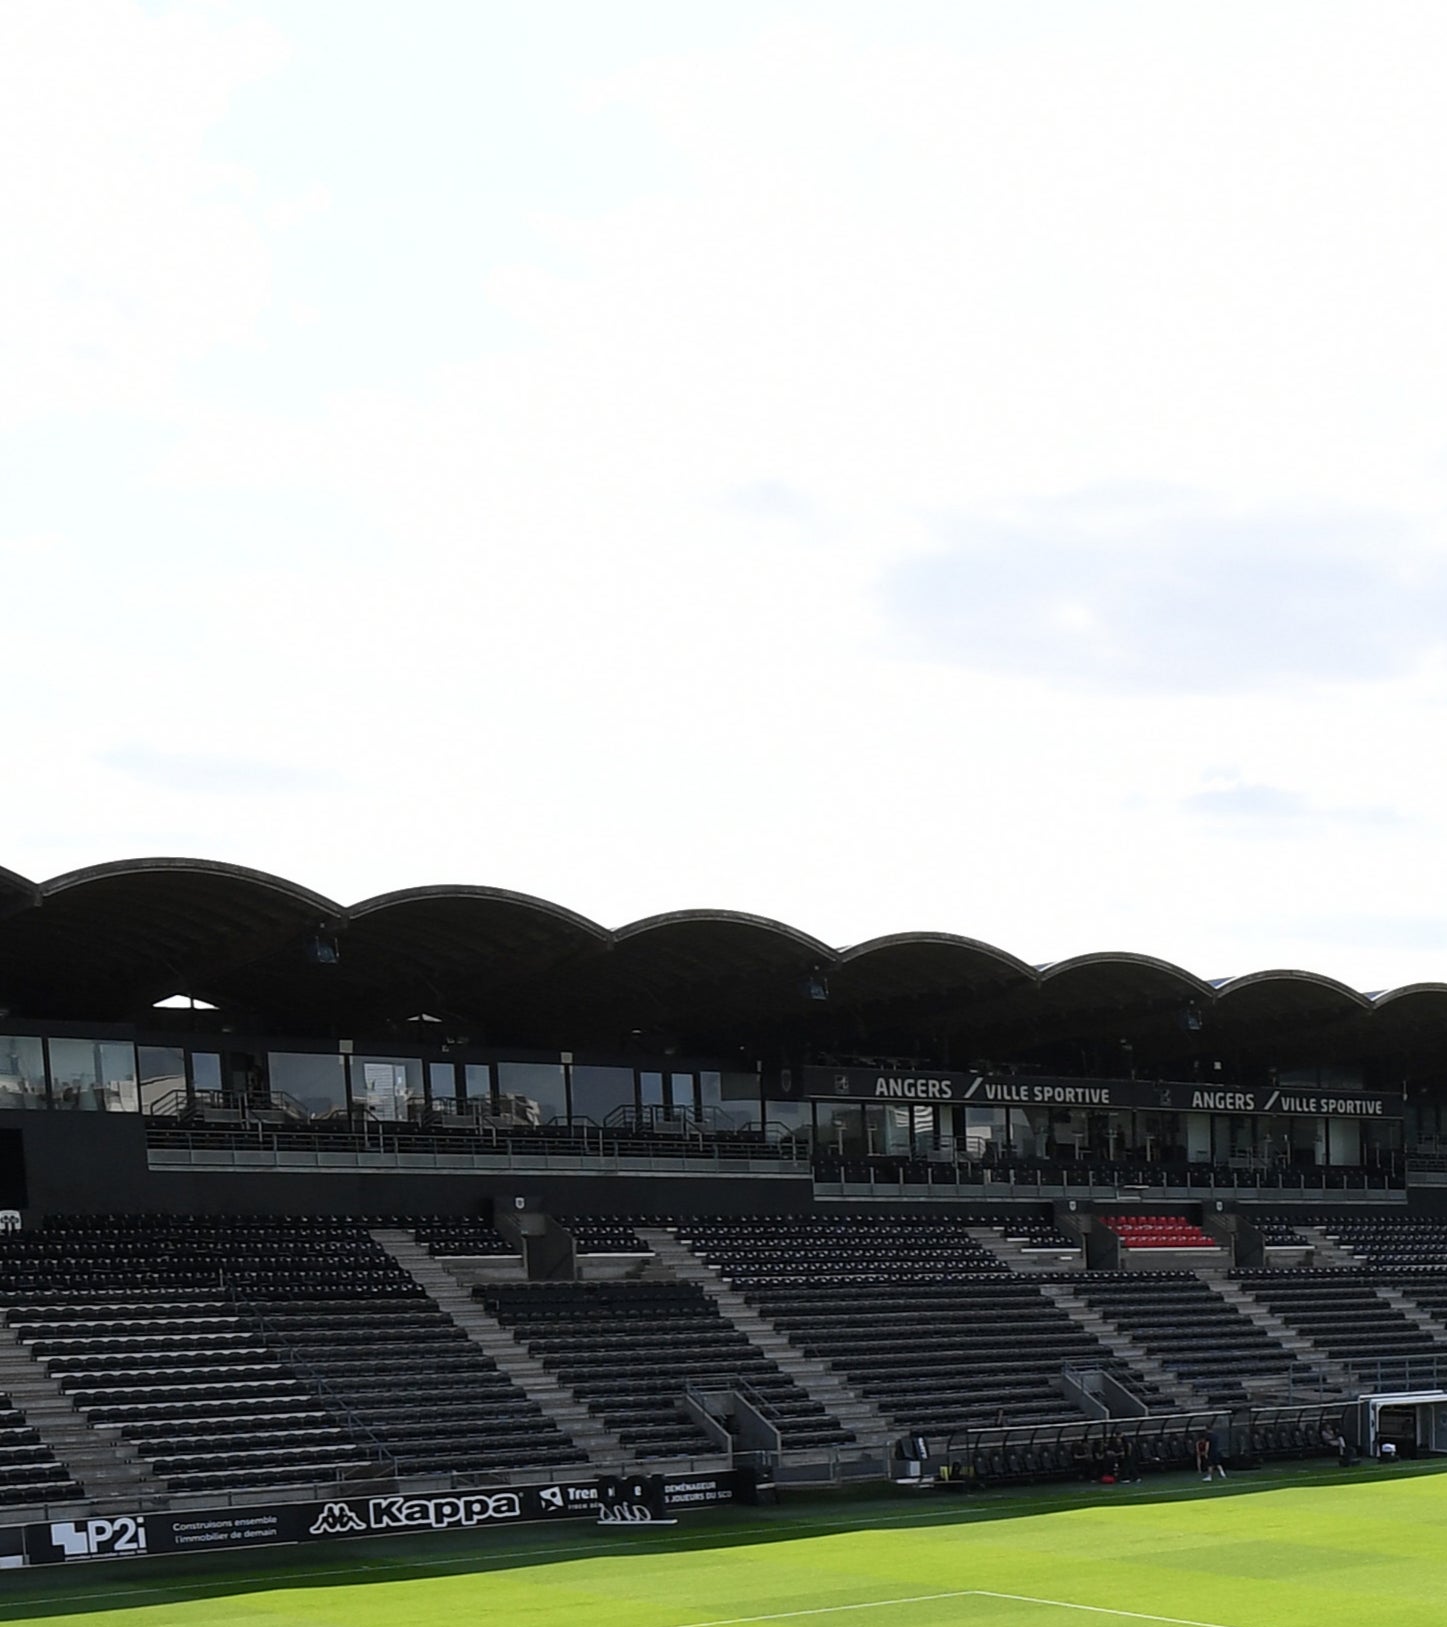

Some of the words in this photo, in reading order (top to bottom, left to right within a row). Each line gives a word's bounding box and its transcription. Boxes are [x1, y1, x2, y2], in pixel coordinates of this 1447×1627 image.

[875, 1077, 952, 1098] ANGERS
[985, 1083, 1028, 1100] VILLE
[1034, 1086, 1110, 1103] SPORTIVE
[1191, 1090, 1254, 1110] ANGERS
[1280, 1096, 1317, 1111] VILLE
[1320, 1098, 1383, 1114] SPORTIVE
[369, 1493, 520, 1528] Kappa
[87, 1516, 147, 1553] P2i
[172, 1519, 233, 1532] Construisons
[234, 1516, 278, 1526] ensemble
[175, 1533, 228, 1544] l'immobilier
[230, 1530, 241, 1539] de
[244, 1528, 277, 1538] demain
